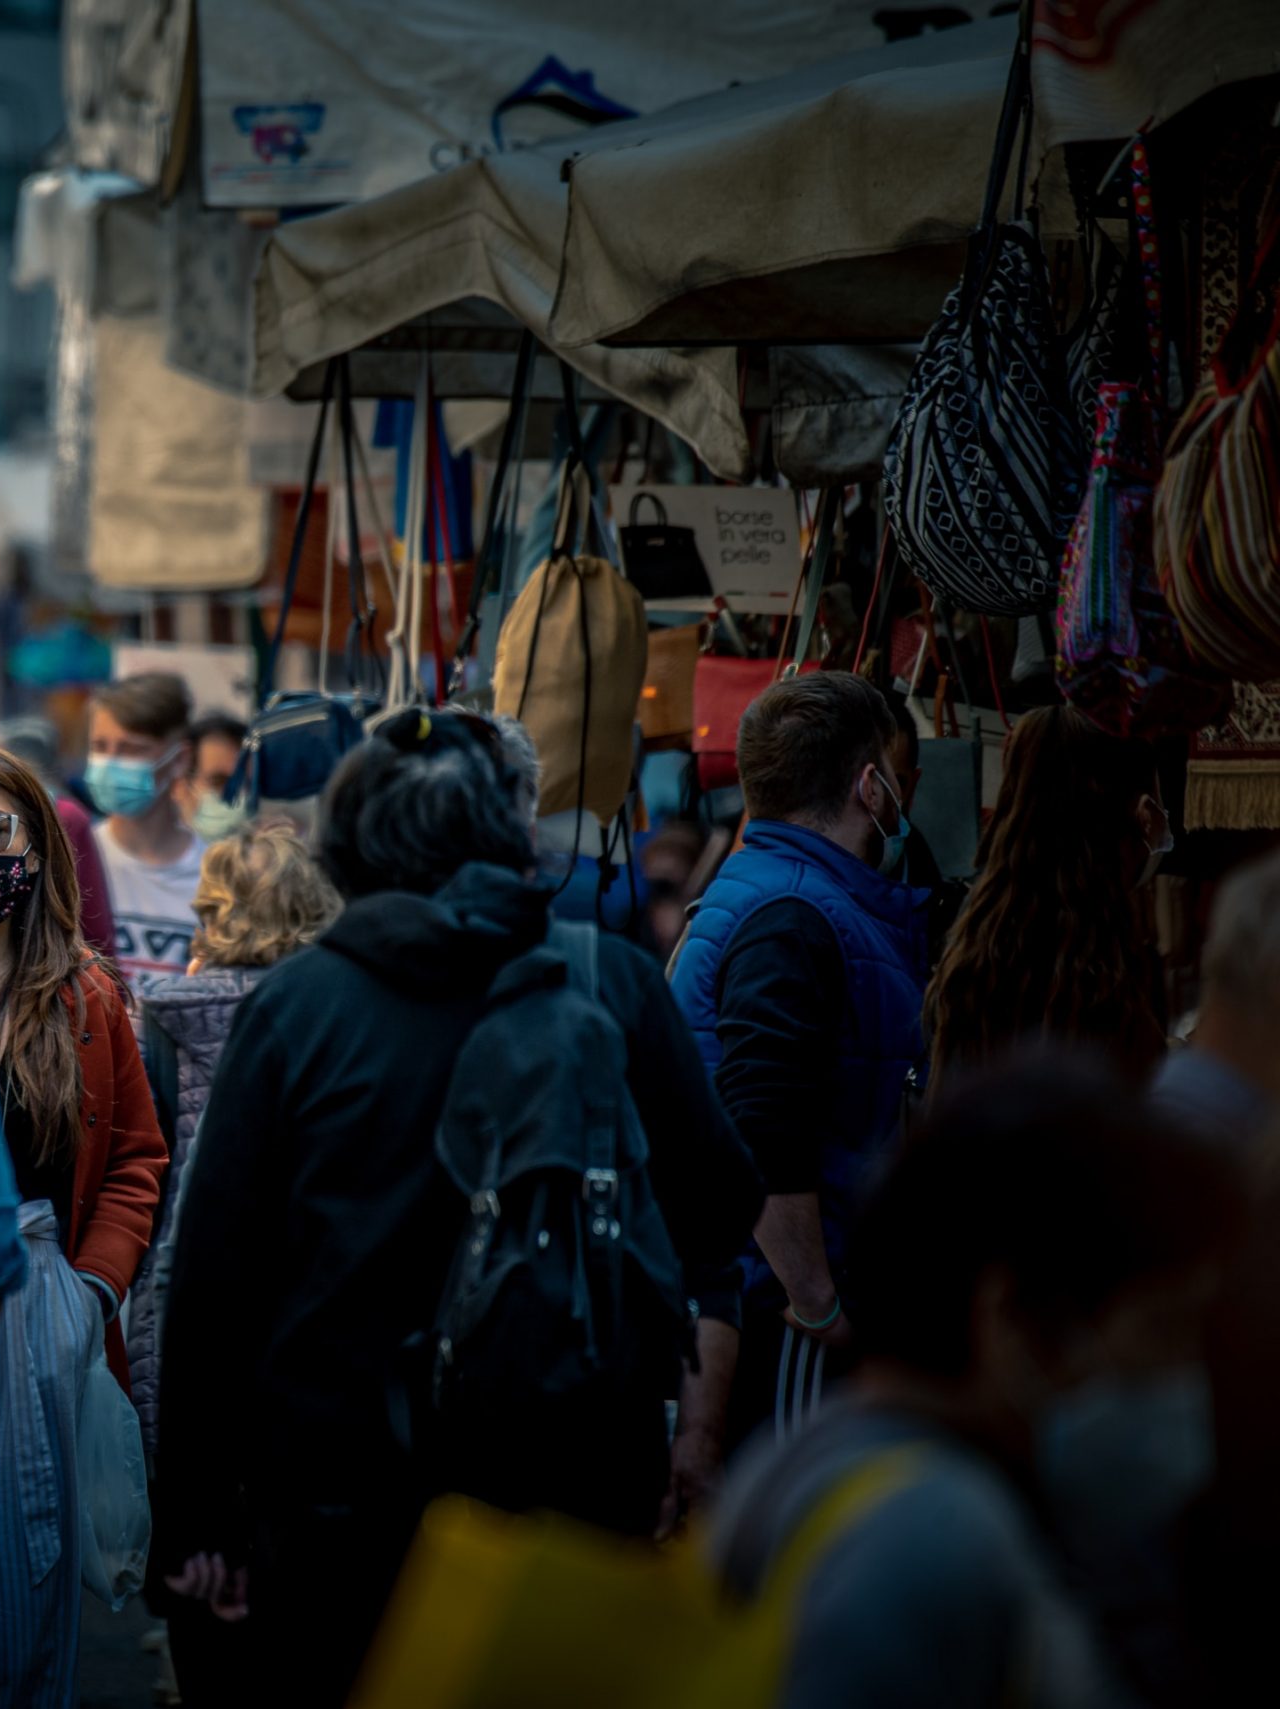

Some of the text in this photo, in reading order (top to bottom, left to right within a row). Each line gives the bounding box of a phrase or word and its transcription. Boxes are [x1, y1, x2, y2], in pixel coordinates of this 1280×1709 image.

[715, 505, 774, 526] borse
[718, 526, 786, 545] in vera
[720, 544, 771, 567] pelle
